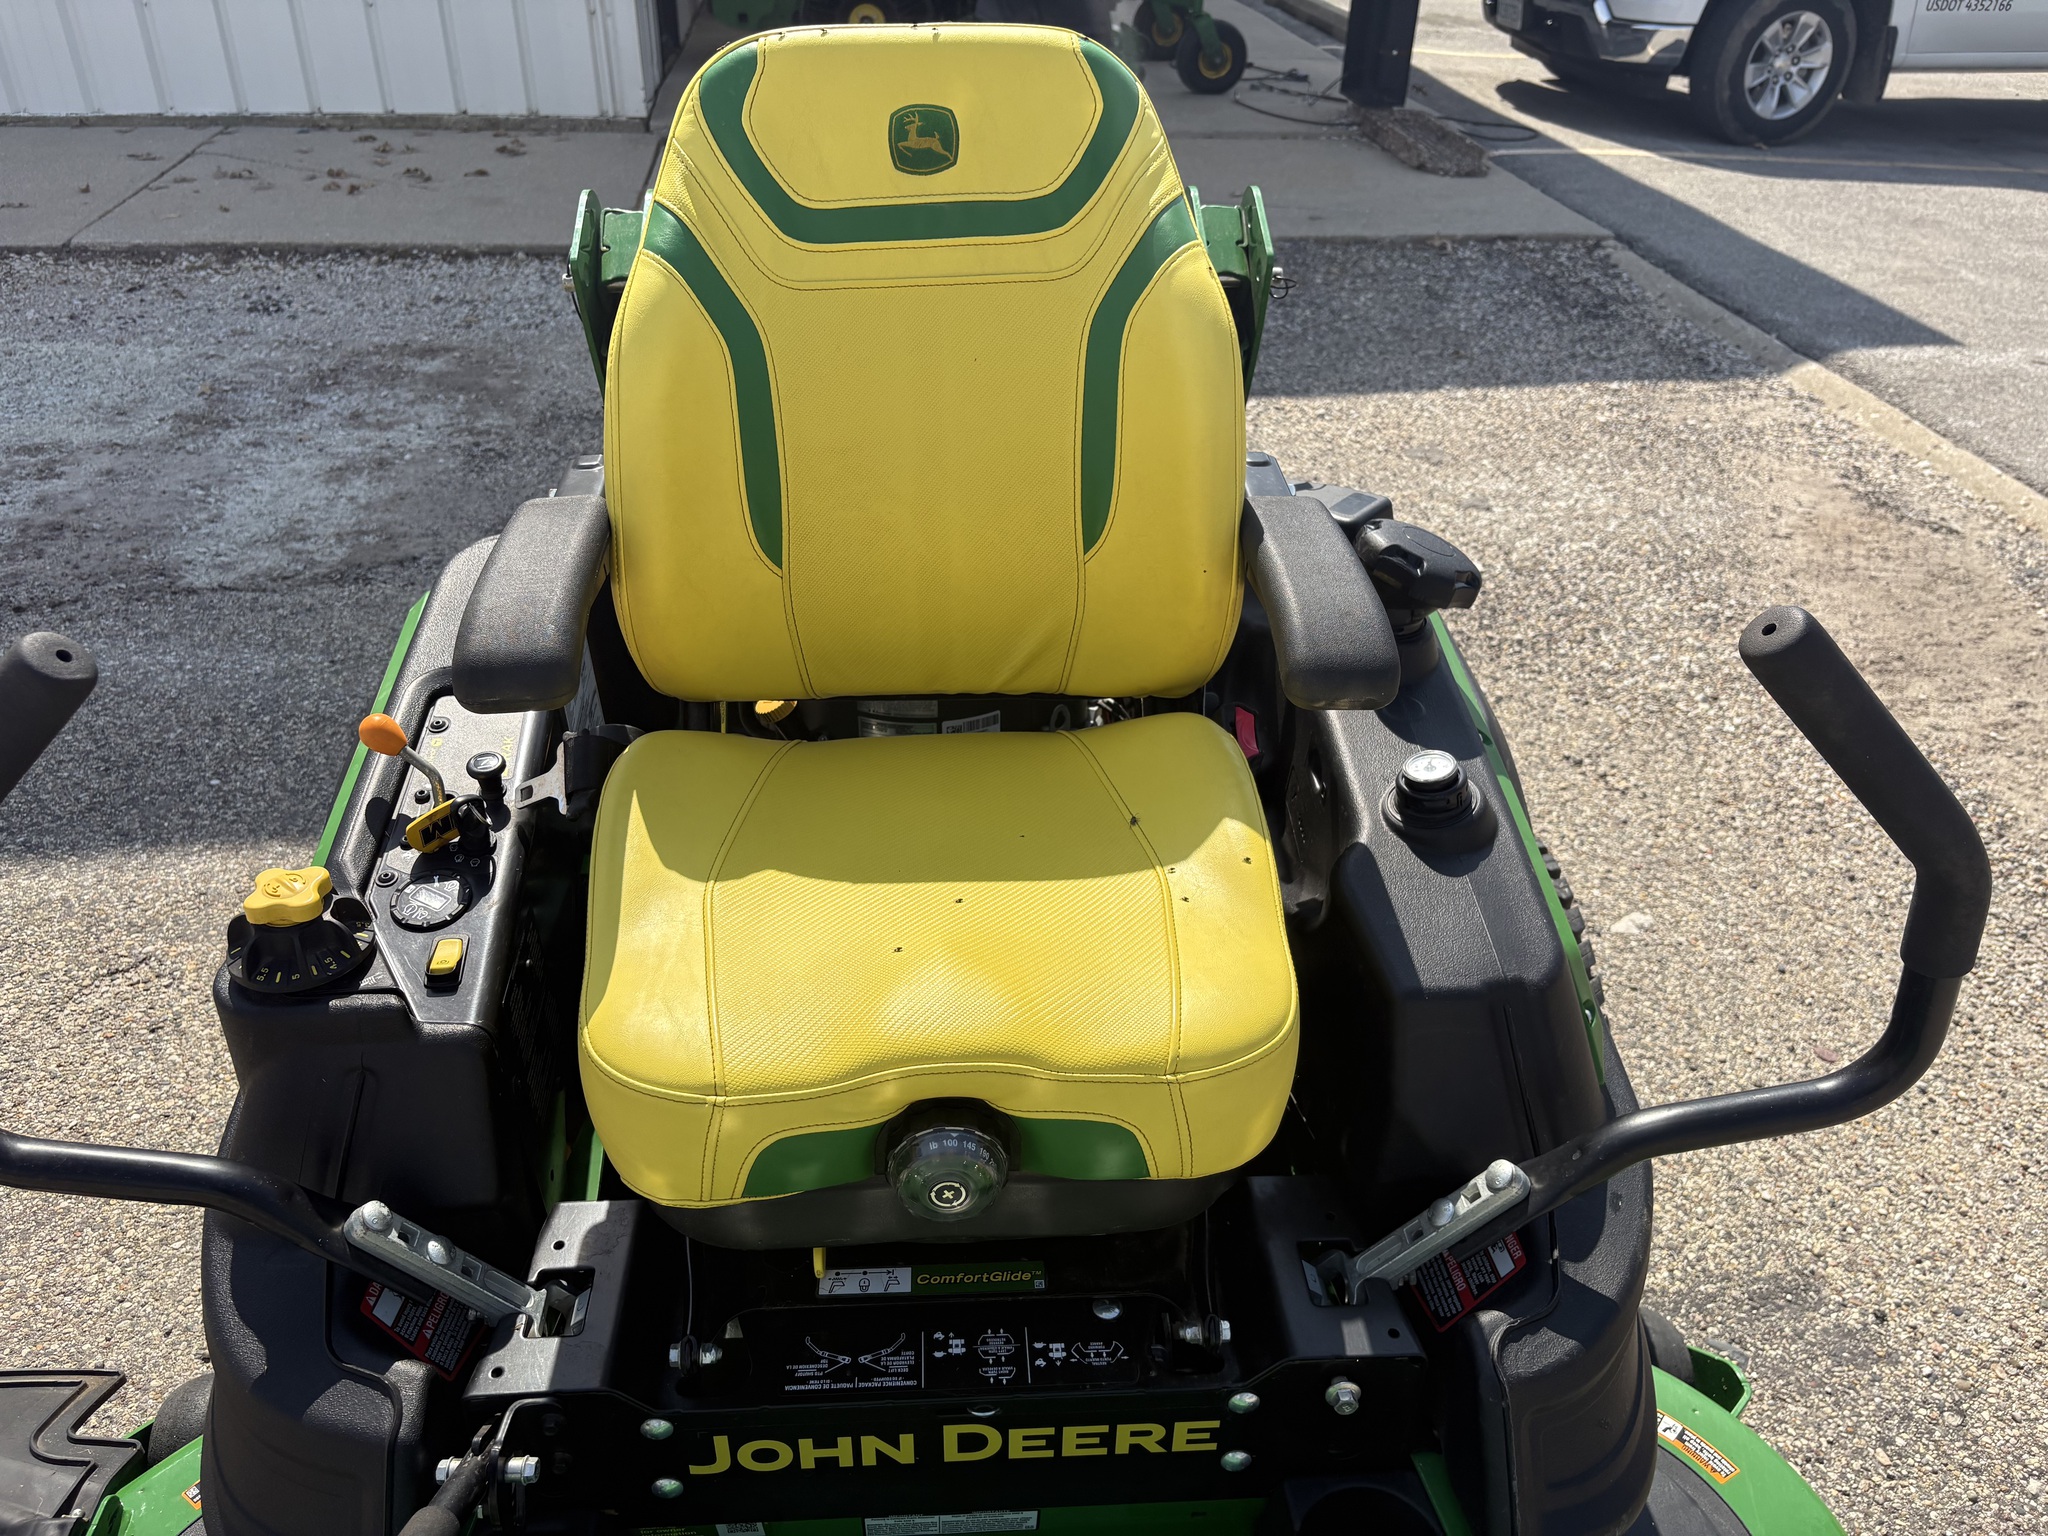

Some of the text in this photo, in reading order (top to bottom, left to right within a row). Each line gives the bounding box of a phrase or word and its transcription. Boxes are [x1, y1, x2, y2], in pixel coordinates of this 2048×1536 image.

[1926, 0, 2013, 11] USDOT 4352166
[256, 967, 269, 982] 5.5
[929, 1141, 938, 1150] lb
[942, 1138, 958, 1148] 100
[962, 1139, 976, 1152] 145
[1506, 1234, 1521, 1259] NGER
[1445, 1255, 1465, 1291] PELIGRO
[689, 1420, 1221, 1475] JOHN DEERE
